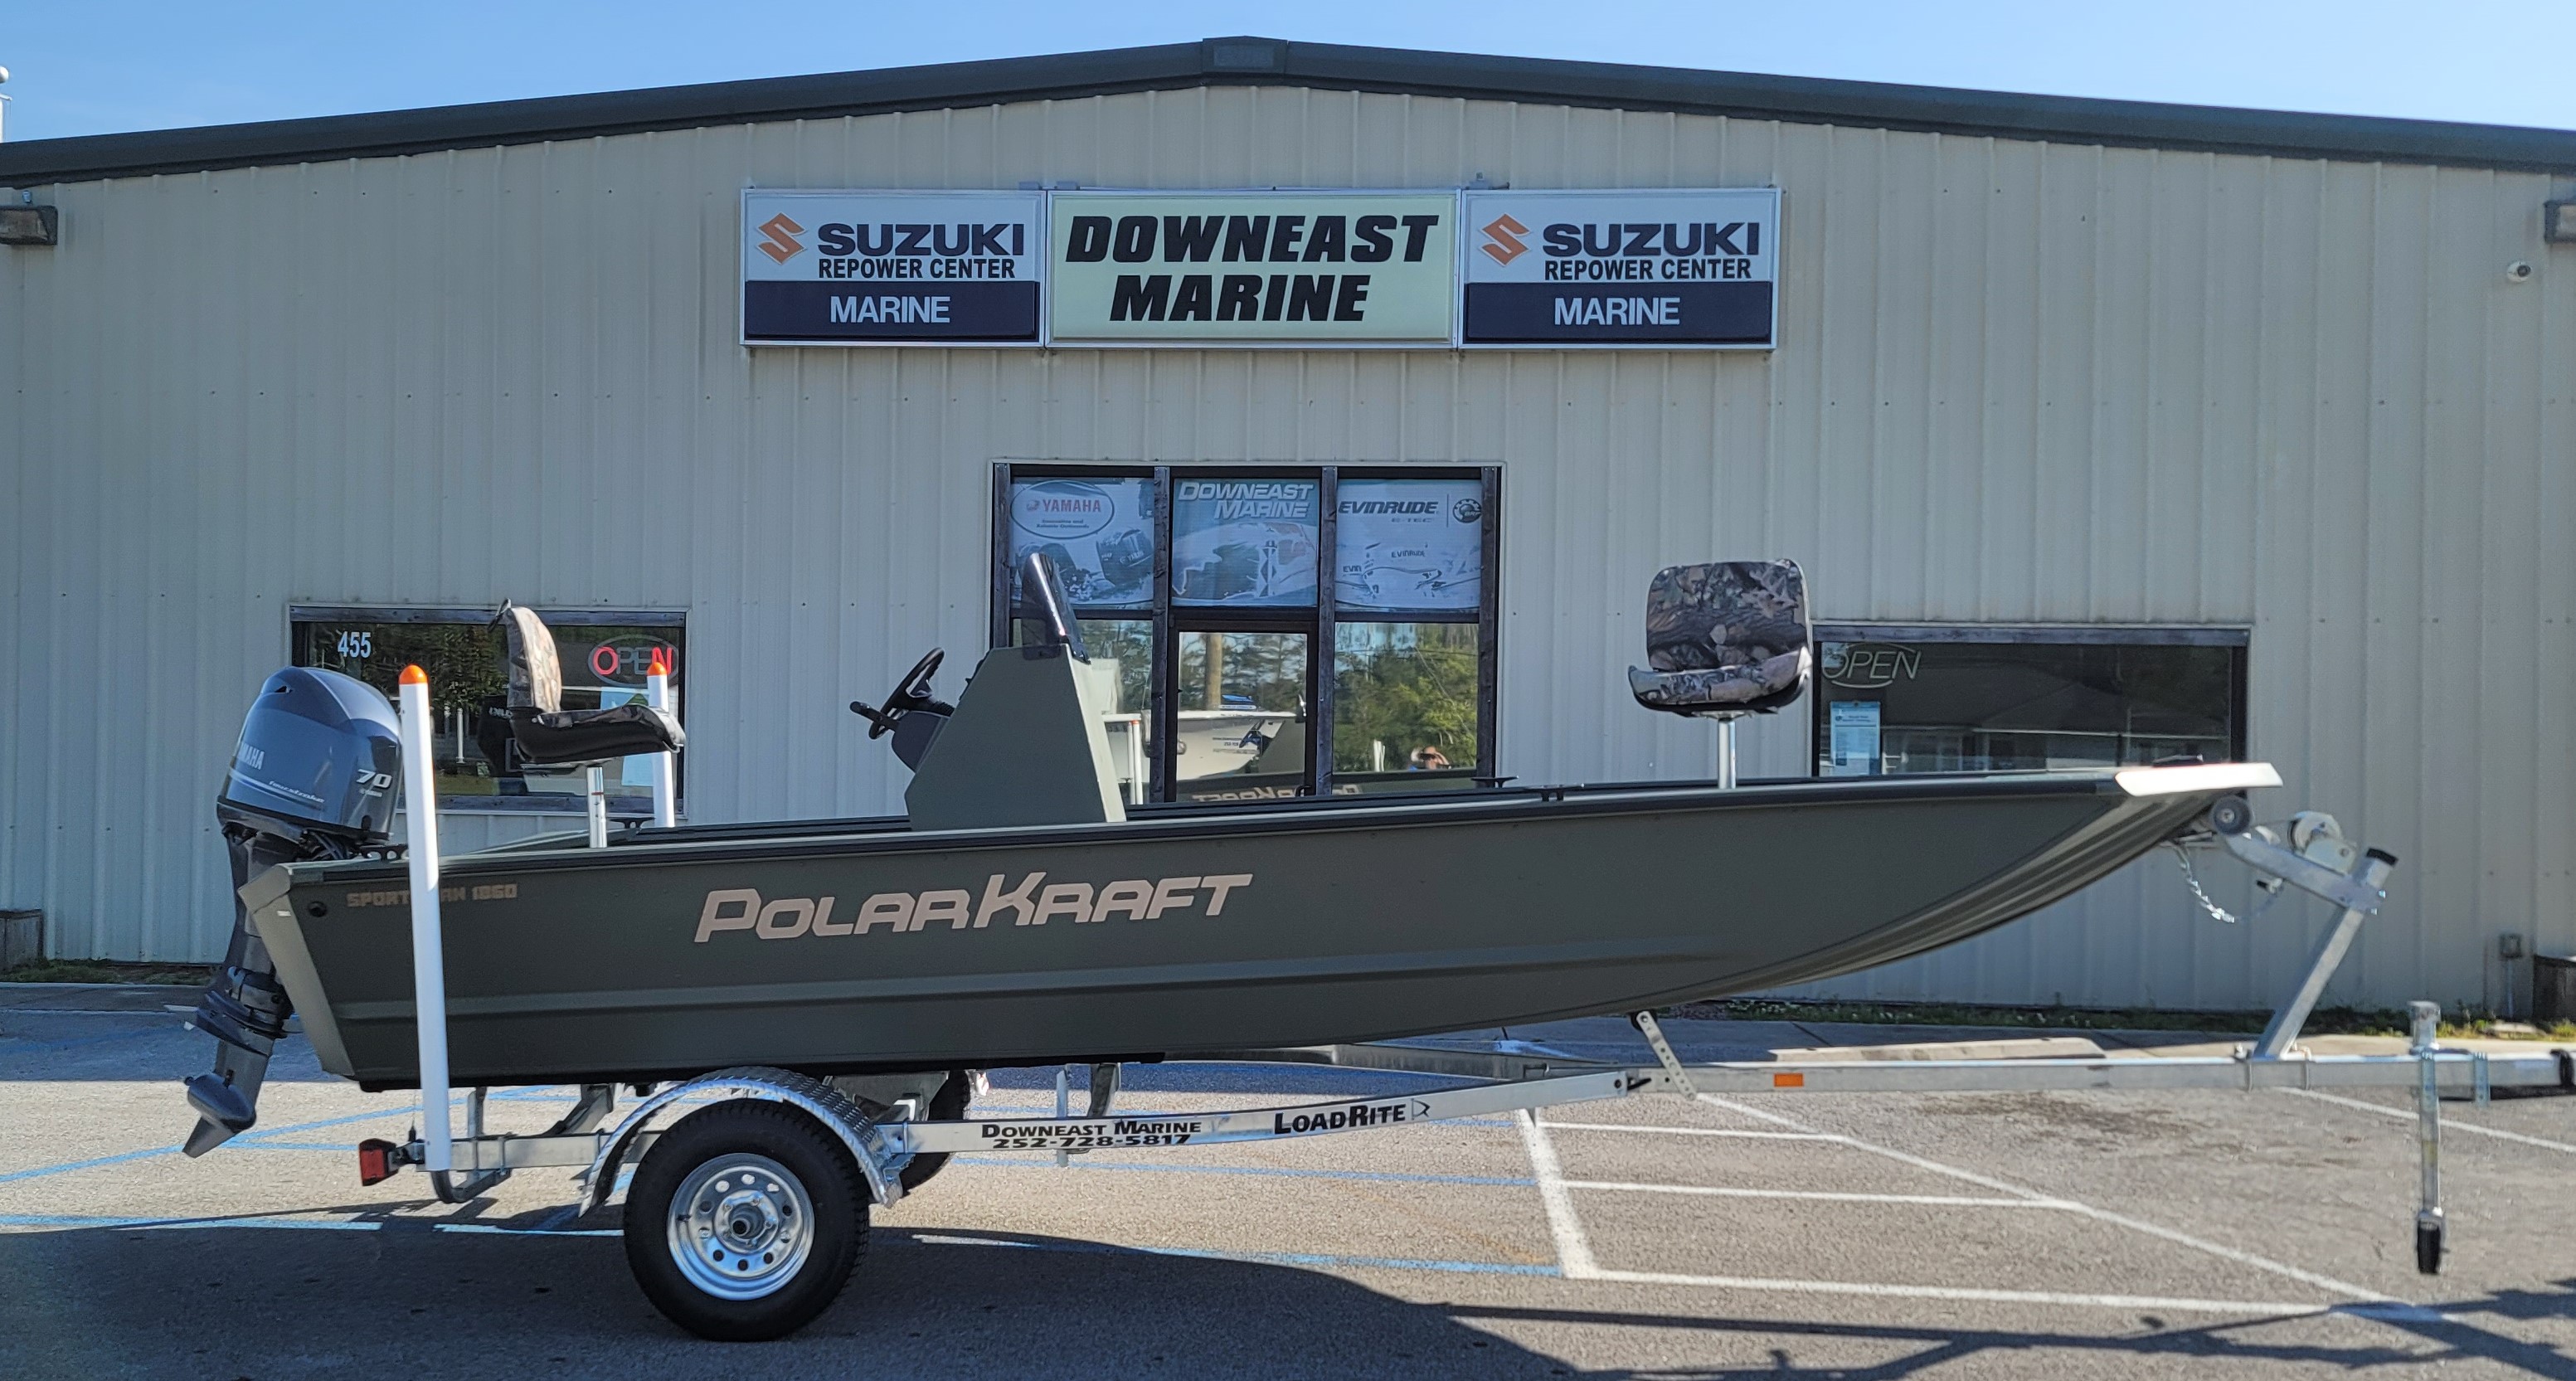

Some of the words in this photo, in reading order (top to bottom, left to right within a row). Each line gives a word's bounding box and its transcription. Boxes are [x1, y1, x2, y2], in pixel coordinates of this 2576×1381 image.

[817, 223, 1024, 256] SUZUKI
[1066, 214, 1440, 263] DOWNEAST
[1542, 221, 1760, 256] SUZUKI
[819, 258, 924, 279] REPOWER
[930, 257, 1016, 279] CENTER
[1545, 259, 1654, 280] REPOWER
[1661, 258, 1752, 280] CENTER
[830, 295, 950, 323] MARINE
[1109, 275, 1371, 322] MARINE
[1554, 296, 1681, 325] MARINE
[1178, 481, 1315, 501] DOWNEAST
[1042, 499, 1101, 513] YAMAHA
[1213, 499, 1310, 519] MARINE
[1338, 500, 1439, 514] EVINRUDE
[1391, 549, 1427, 558] EVINRUDE
[338, 630, 372, 659] 455
[593, 645, 673, 676] OPEN
[1822, 650, 1922, 679] OPEN
[356, 768, 393, 789] 70
[347, 886, 466, 907] SPORTAN
[982, 1124, 1107, 1138] DOWNEAST
[1114, 1120, 1202, 1135] MARINE
[1274, 1104, 1407, 1135] LOADRITE
[993, 1134, 1192, 1149] 252-728-5817
